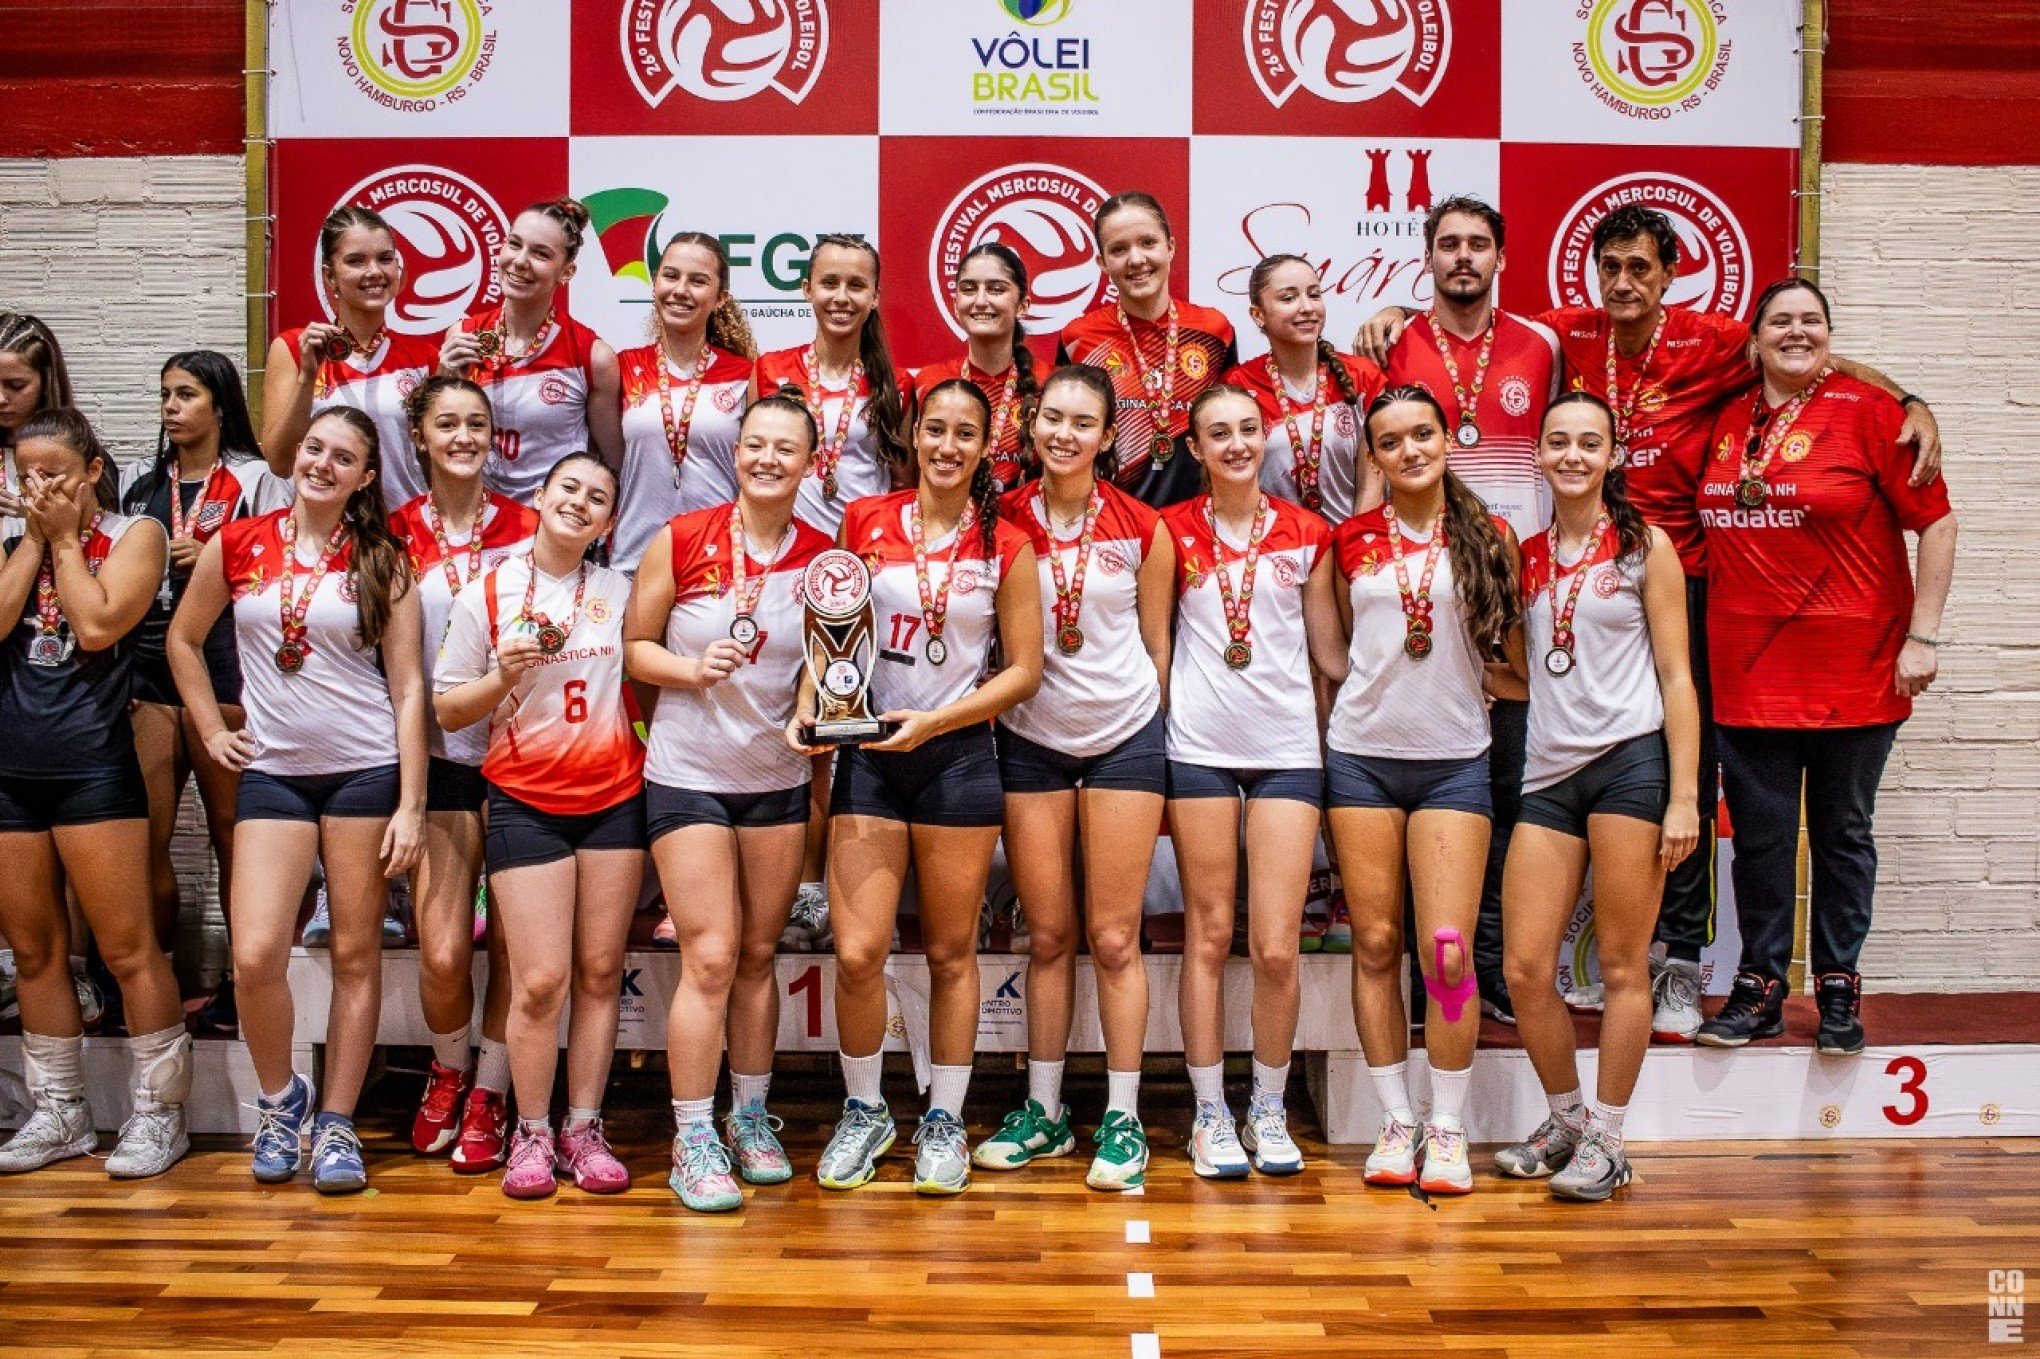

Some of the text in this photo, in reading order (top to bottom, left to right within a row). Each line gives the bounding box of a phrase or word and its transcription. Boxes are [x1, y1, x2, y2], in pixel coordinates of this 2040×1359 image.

[336, 36, 359, 77] NOVO
[355, 76, 436, 112] HAMBURGO
[446, 86, 466, 104] RS
[469, 30, 497, 82] BRASIL
[971, 30, 1090, 69] VÔLEI
[973, 72, 1101, 101] BRASIL
[1572, 42, 1594, 83] NOVO
[1590, 82, 1671, 120] HAMBURGO
[1681, 94, 1701, 112] RS
[1705, 38, 1732, 90] BRASIL
[369, 179, 461, 205] MERCOSUL
[464, 198, 487, 223] DE
[944, 199, 989, 277] FESTIVAL
[987, 177, 1081, 204] MERCOSUL
[1357, 217, 1425, 236] HOTÉ
[719, 232, 865, 291] FG
[1563, 206, 1607, 283] FESTIVAL
[1604, 186, 1699, 213] MERCOSUL
[1698, 206, 1722, 231] DE
[1715, 229, 1740, 312] VOLEIBOL
[751, 306, 795, 318] GAÚCHA
[798, 308, 812, 318] DE
[1776, 483, 1797, 496] NH
[600, 645, 614, 656] NH
[891, 613, 922, 652] 17
[564, 680, 588, 723] 6
[789, 965, 821, 1037] 1
[1882, 1056, 1930, 1126] 3
